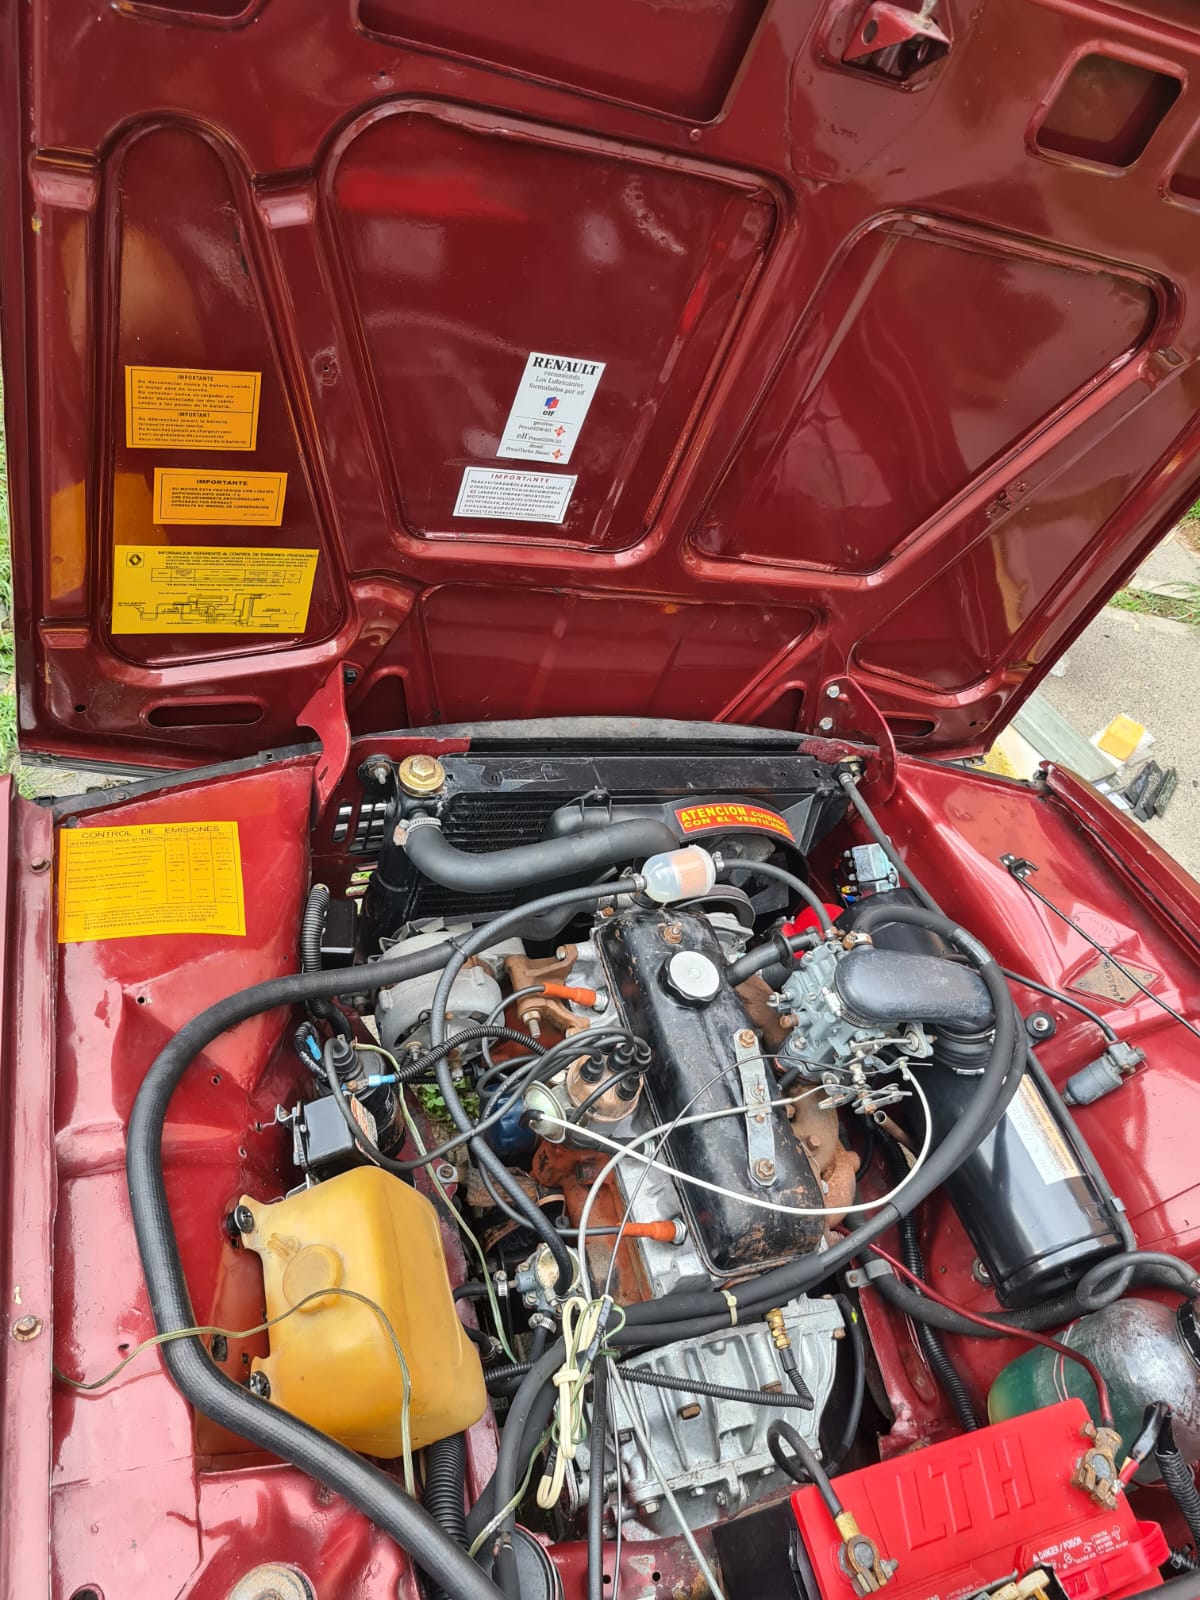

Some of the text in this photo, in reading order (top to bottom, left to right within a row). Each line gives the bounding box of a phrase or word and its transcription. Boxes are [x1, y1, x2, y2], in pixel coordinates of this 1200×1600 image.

[532, 356, 599, 376] RENAULT
[490, 473, 550, 482] IMPORTANTE
[681, 806, 748, 822] ATENCION
[684, 818, 711, 828] CON
[81, 829, 132, 839] CONTROL
[164, 825, 220, 834] EMISIONES
[896, 1433, 1036, 1552] LTH
[1038, 1544, 1060, 1559] DANGER
